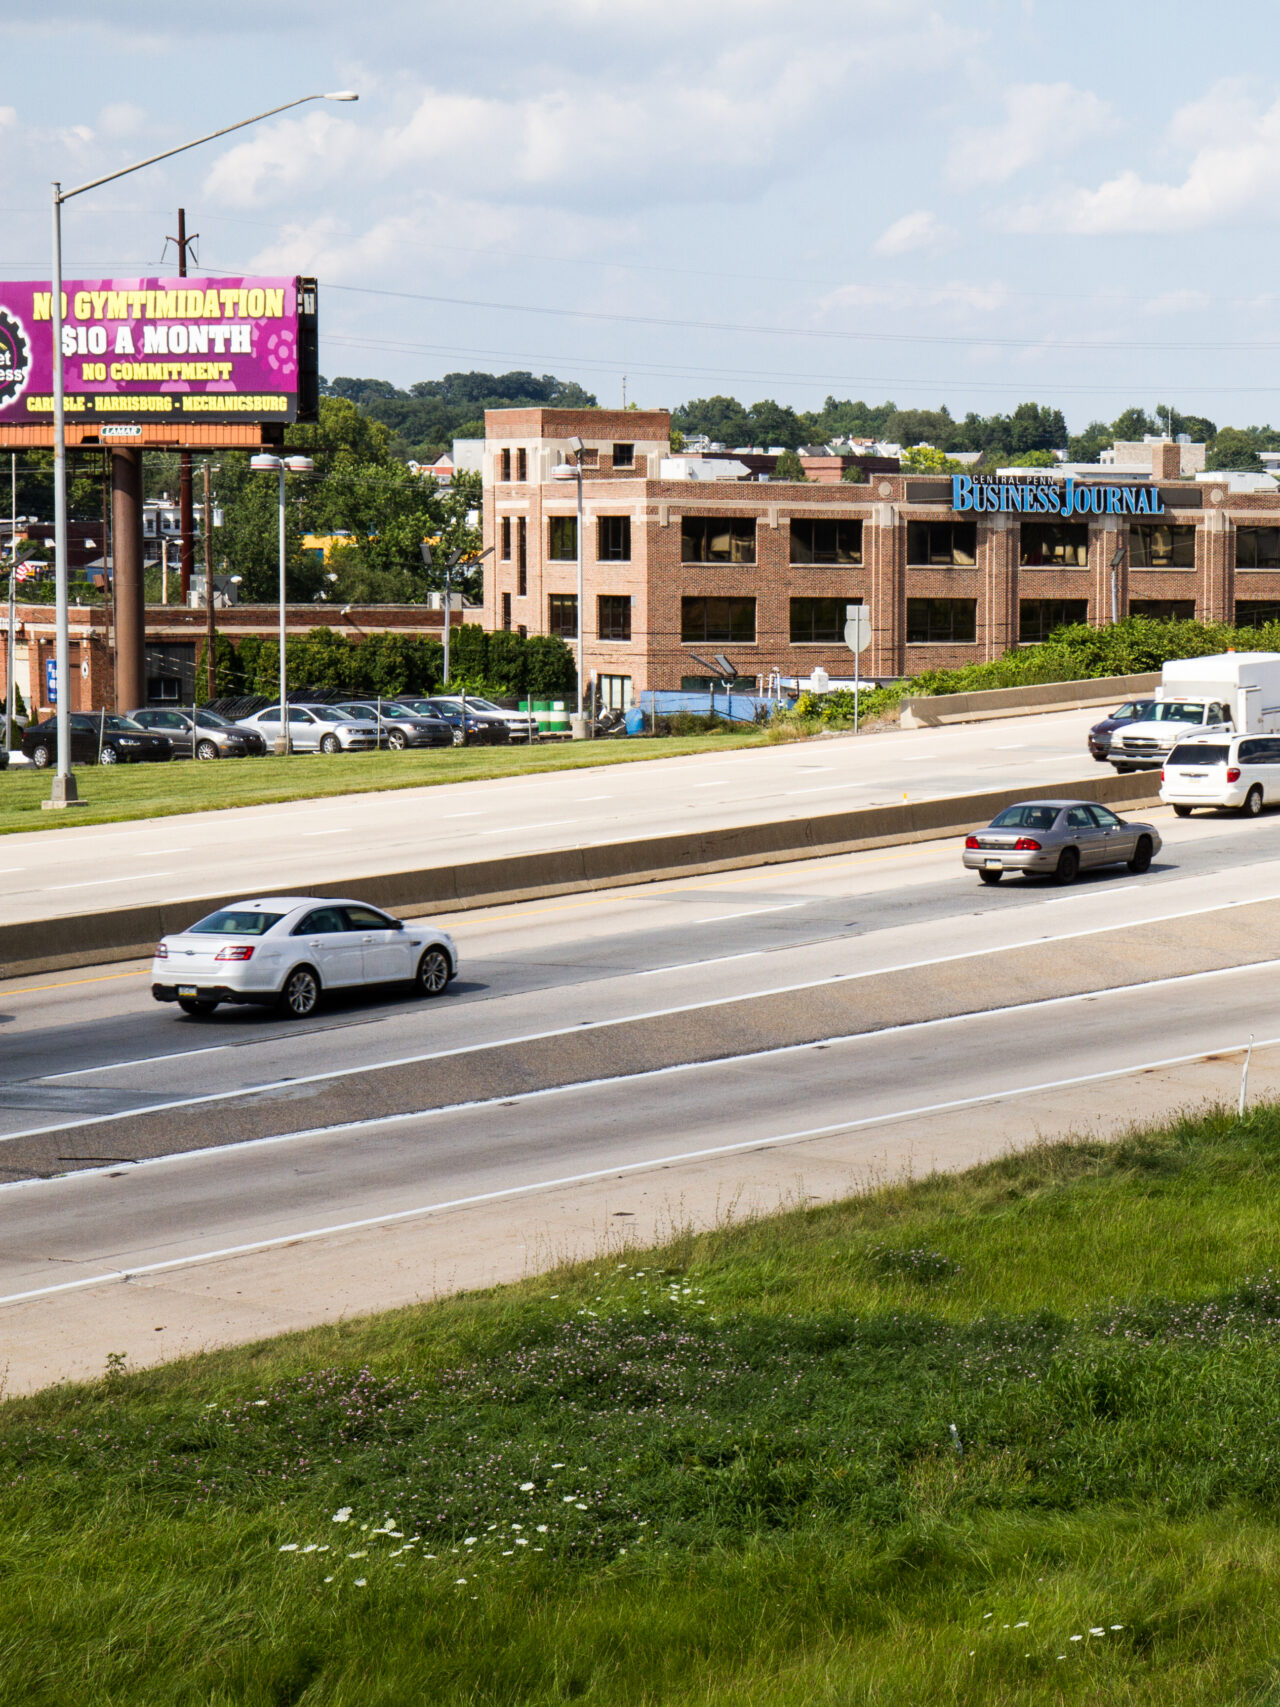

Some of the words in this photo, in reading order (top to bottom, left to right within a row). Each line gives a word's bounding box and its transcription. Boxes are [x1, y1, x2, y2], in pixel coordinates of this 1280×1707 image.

[33, 292, 67, 320] NO
[74, 288, 285, 320] GYMTIMIDATION
[62, 325, 107, 356] $10
[114, 326, 135, 354] A
[143, 324, 251, 354] MONTH
[82, 363, 106, 381] NO
[110, 362, 232, 381] COMMITMENT
[27, 396, 86, 412] CARLSLE
[95, 396, 172, 412] HARRISBURG
[183, 396, 288, 412] MECHANICSBURG
[973, 475, 1021, 485] CENTRAL
[1027, 476, 1054, 485] PENN
[951, 474, 1060, 512] BUSINESS
[1060, 478, 1165, 517] JOURNAL
